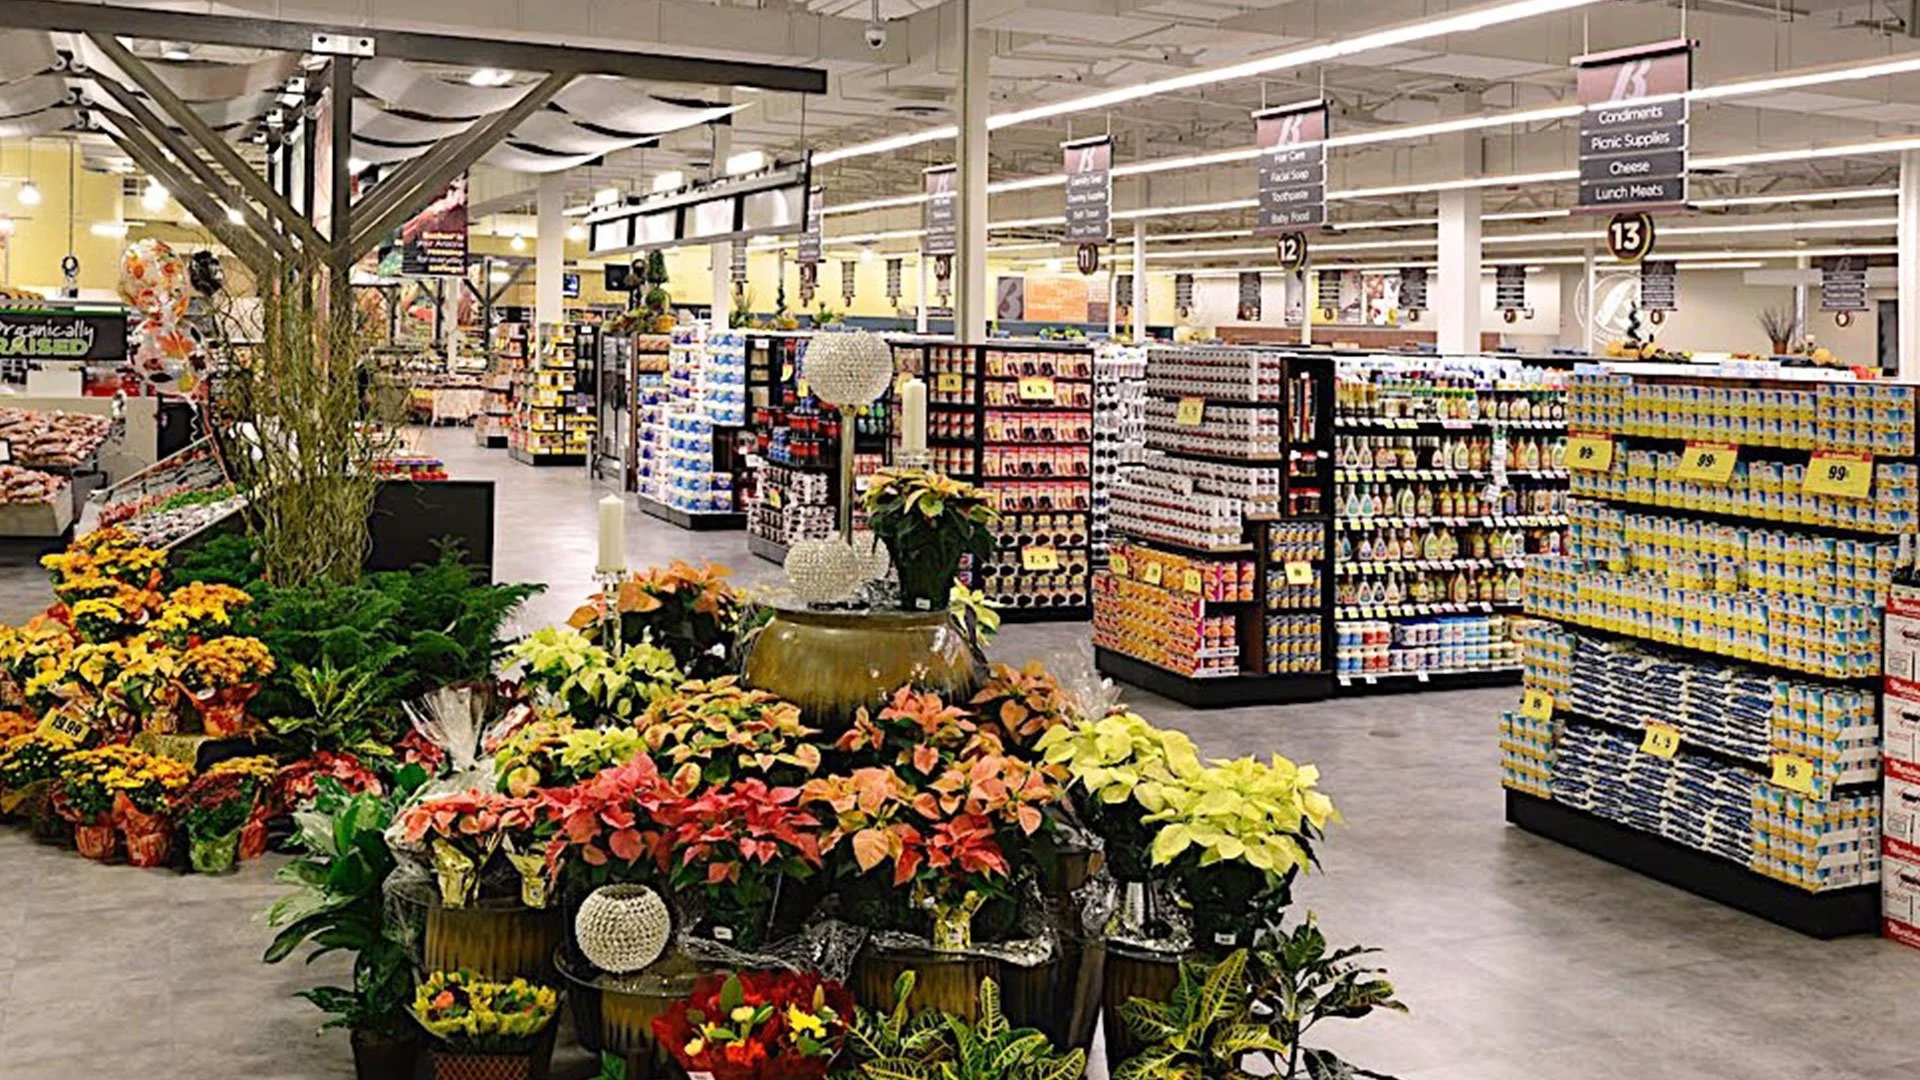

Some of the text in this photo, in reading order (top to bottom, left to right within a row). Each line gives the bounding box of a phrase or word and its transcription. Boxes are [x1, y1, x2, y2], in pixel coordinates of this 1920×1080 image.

[1598, 106, 1664, 125] Condiments
[1591, 132, 1670, 151] Picnic Supplies
[1270, 169, 1309, 183] Facial Soap
[1609, 161, 1650, 175] Cheese
[1272, 190, 1309, 204] Toothpaste
[1595, 183, 1664, 201] Lunch Meats
[1271, 211, 1310, 225] Baby Food
[1611, 222, 1641, 250] 13
[1080, 250, 1089, 268] 11
[1278, 239, 1297, 262] 12
